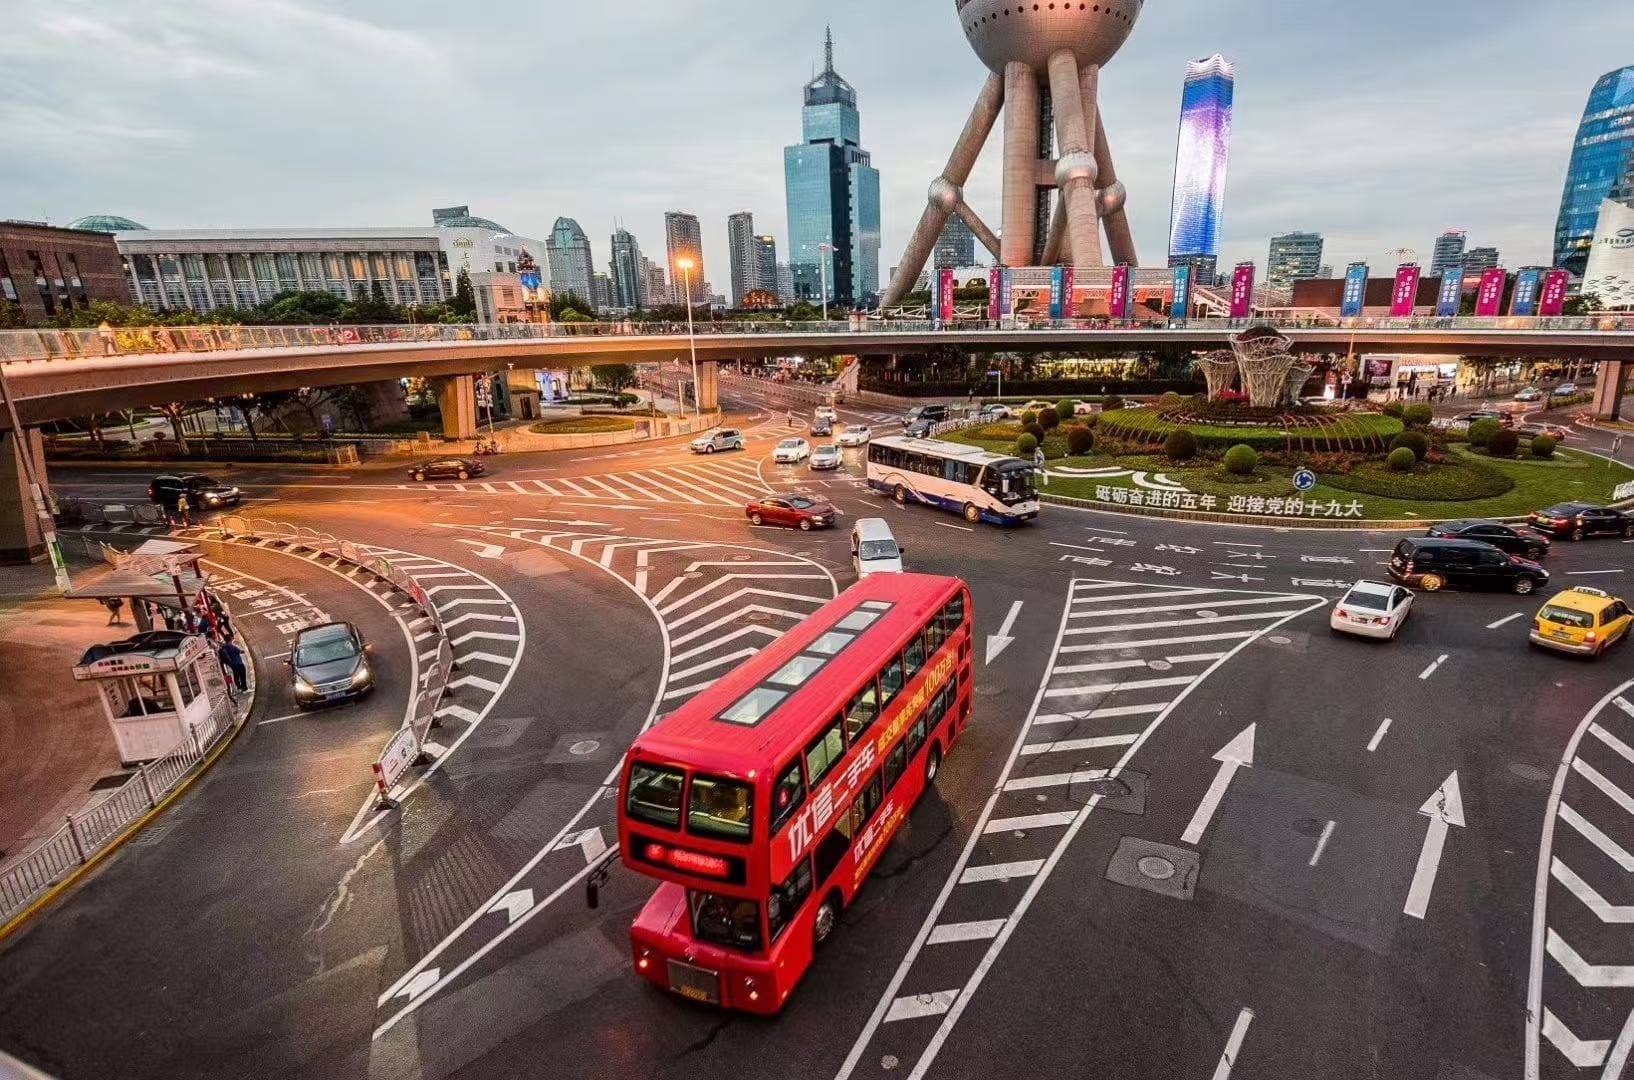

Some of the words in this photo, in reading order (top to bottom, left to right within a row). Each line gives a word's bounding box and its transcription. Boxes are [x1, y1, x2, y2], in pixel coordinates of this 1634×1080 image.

[1096, 484, 1217, 511] 砥砺奋进的五年
[1227, 495, 1364, 517] 迎接党的十九大
[788, 739, 875, 862] 优信二手车
